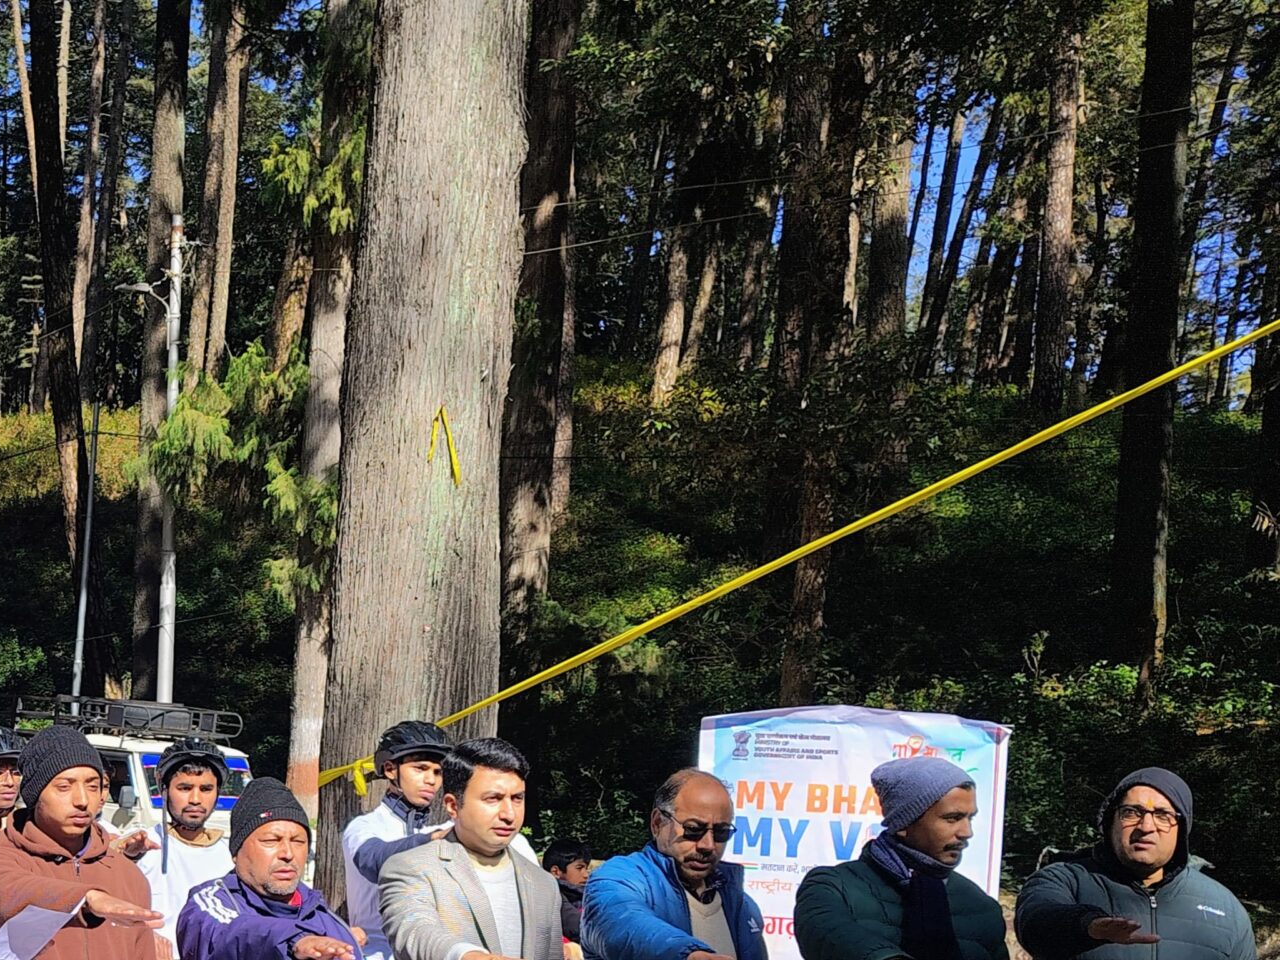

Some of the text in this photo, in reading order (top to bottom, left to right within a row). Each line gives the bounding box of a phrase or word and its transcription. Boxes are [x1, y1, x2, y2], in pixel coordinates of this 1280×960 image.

[736, 780, 884, 817] MY BHA
[732, 816, 810, 859] MY
[747, 878, 793, 895] राष्ट्रीय
